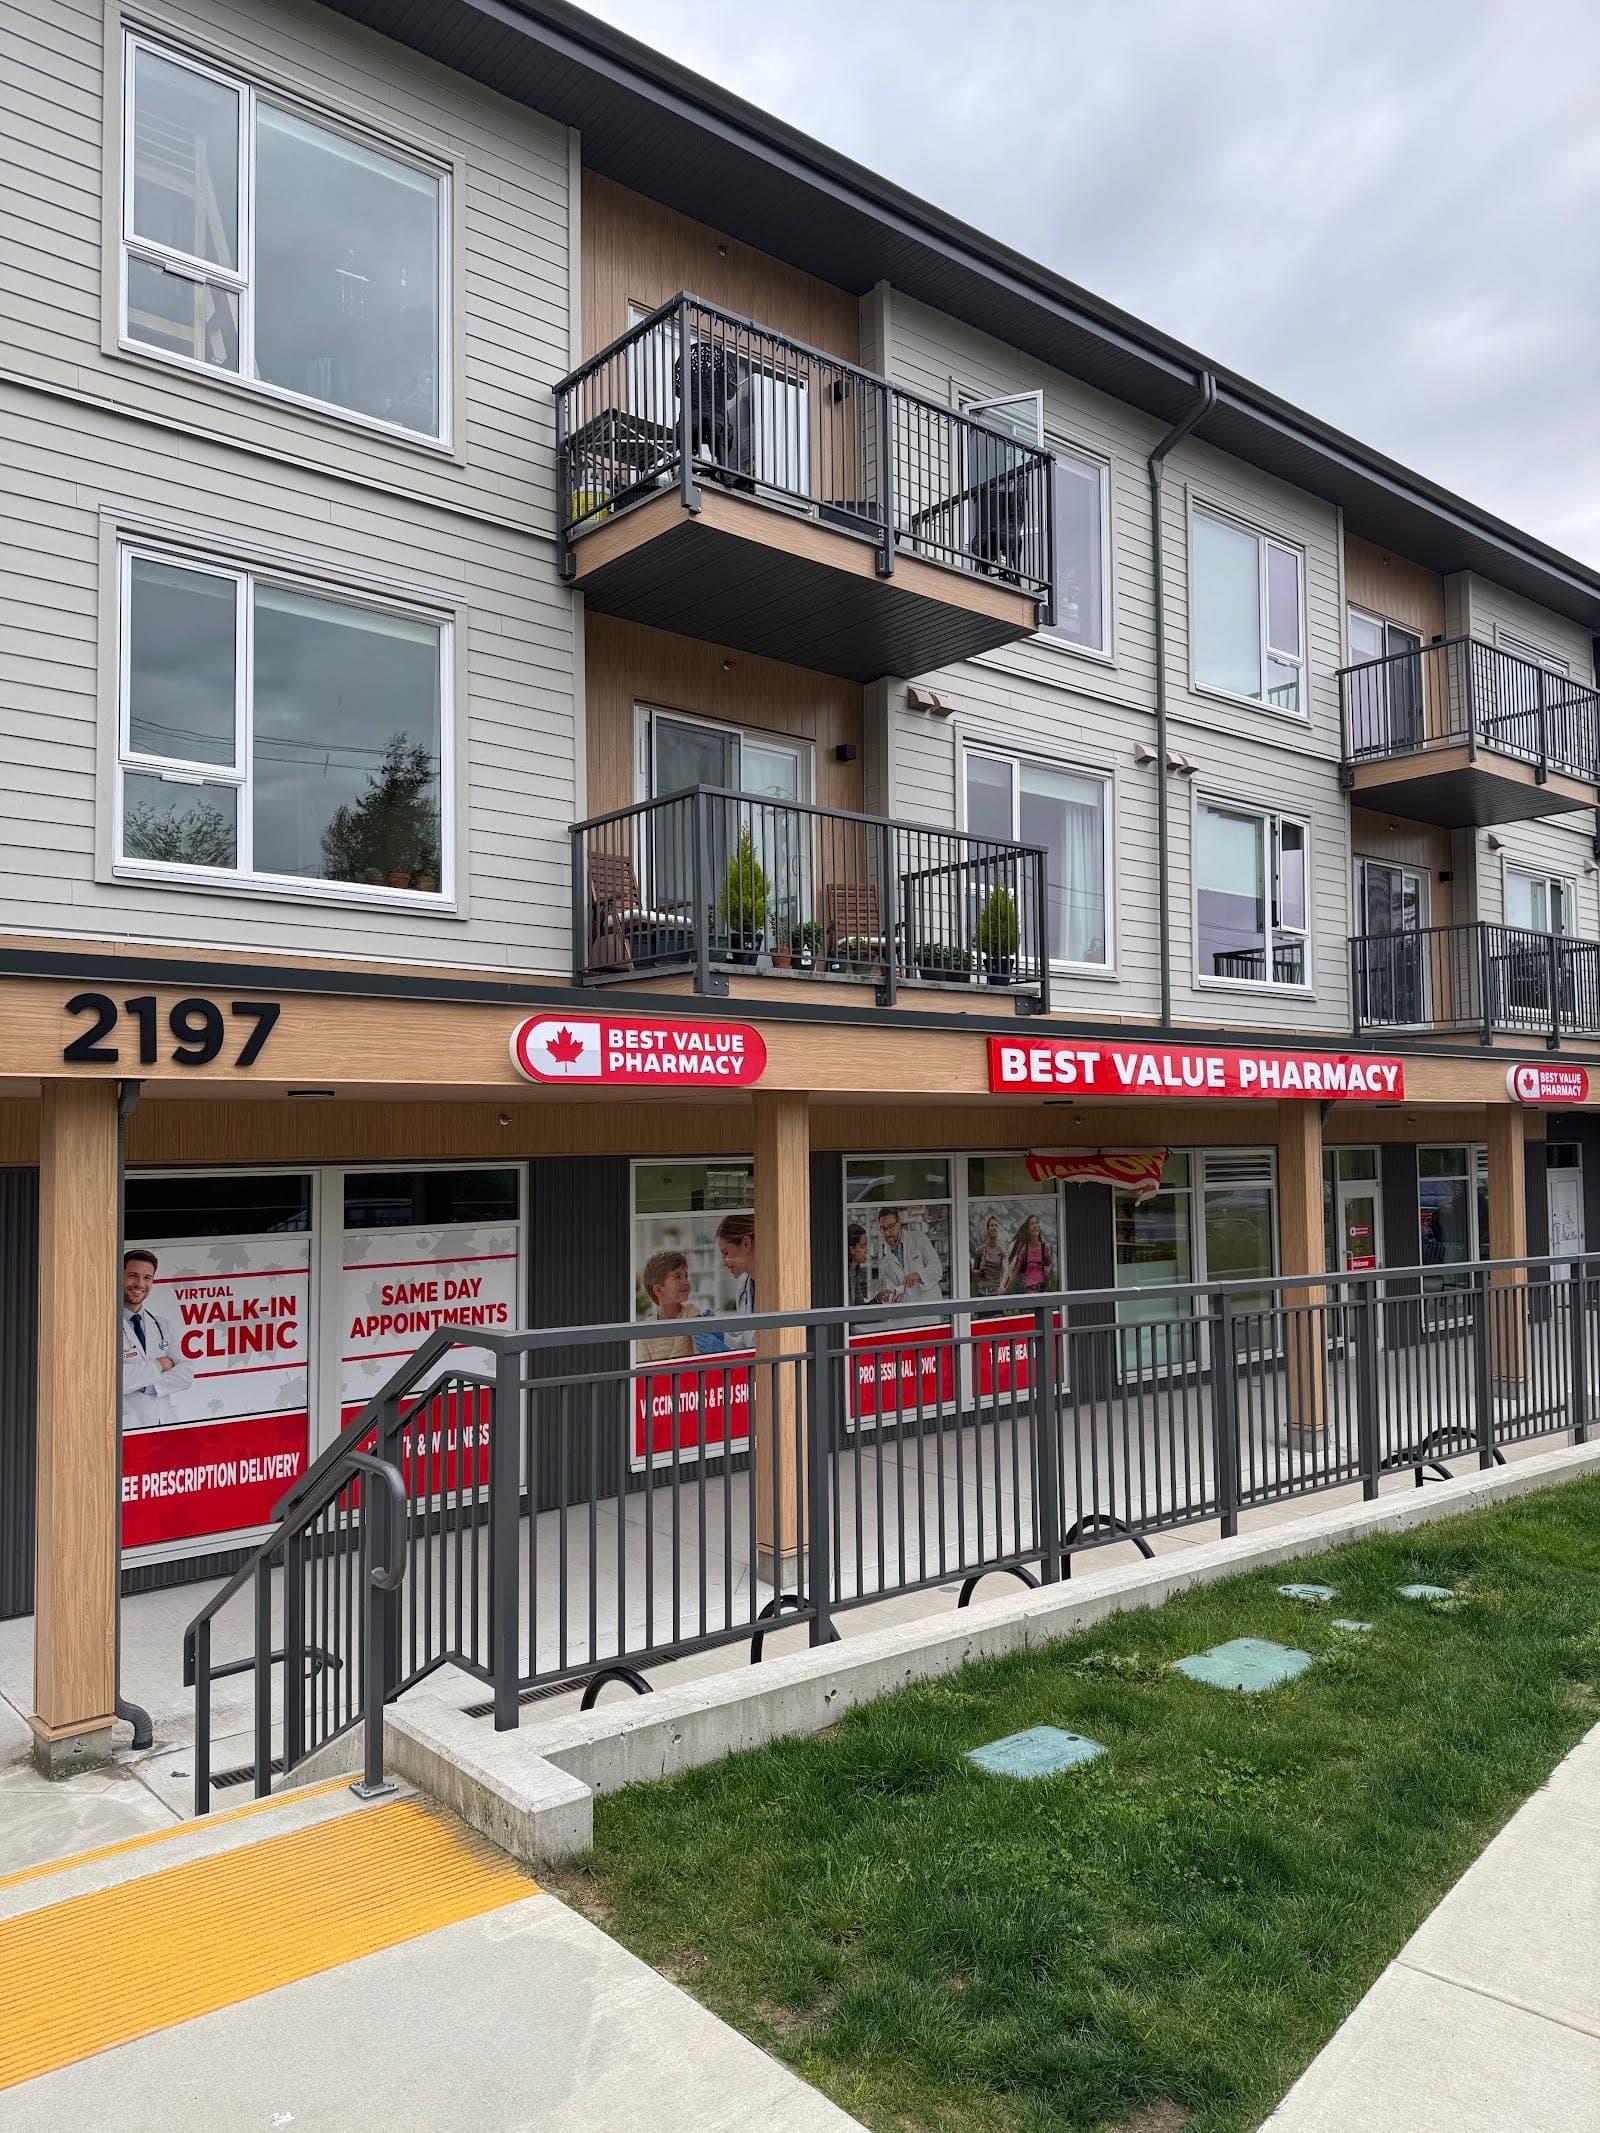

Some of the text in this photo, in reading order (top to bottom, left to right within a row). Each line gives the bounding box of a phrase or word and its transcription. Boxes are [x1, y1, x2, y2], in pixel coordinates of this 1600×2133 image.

[64, 993, 281, 1066] 2197
[608, 1029, 745, 1053] BEST VALUE
[609, 1051, 745, 1075] PHARMACY
[1000, 1048, 1399, 1092] BEST VALUE PHARMACY
[1540, 1071, 1582, 1084] BEST VALUE
[1541, 1084, 1582, 1097] PHARMACY
[175, 1285, 234, 1300] VIRTUAL
[381, 1277, 483, 1306] SAME DAY
[180, 1295, 297, 1326] WALK-IN
[350, 1302, 508, 1339] APPOINTMENTS
[180, 1320, 299, 1360] CLINIC
[859, 1359, 914, 1385] PROSSIAL
[640, 1388, 707, 1419] VCCINTIO
[431, 1423, 490, 1454] WLNESS
[121, 1452, 300, 1502] EE PRESCRIPTION DELIVERY
